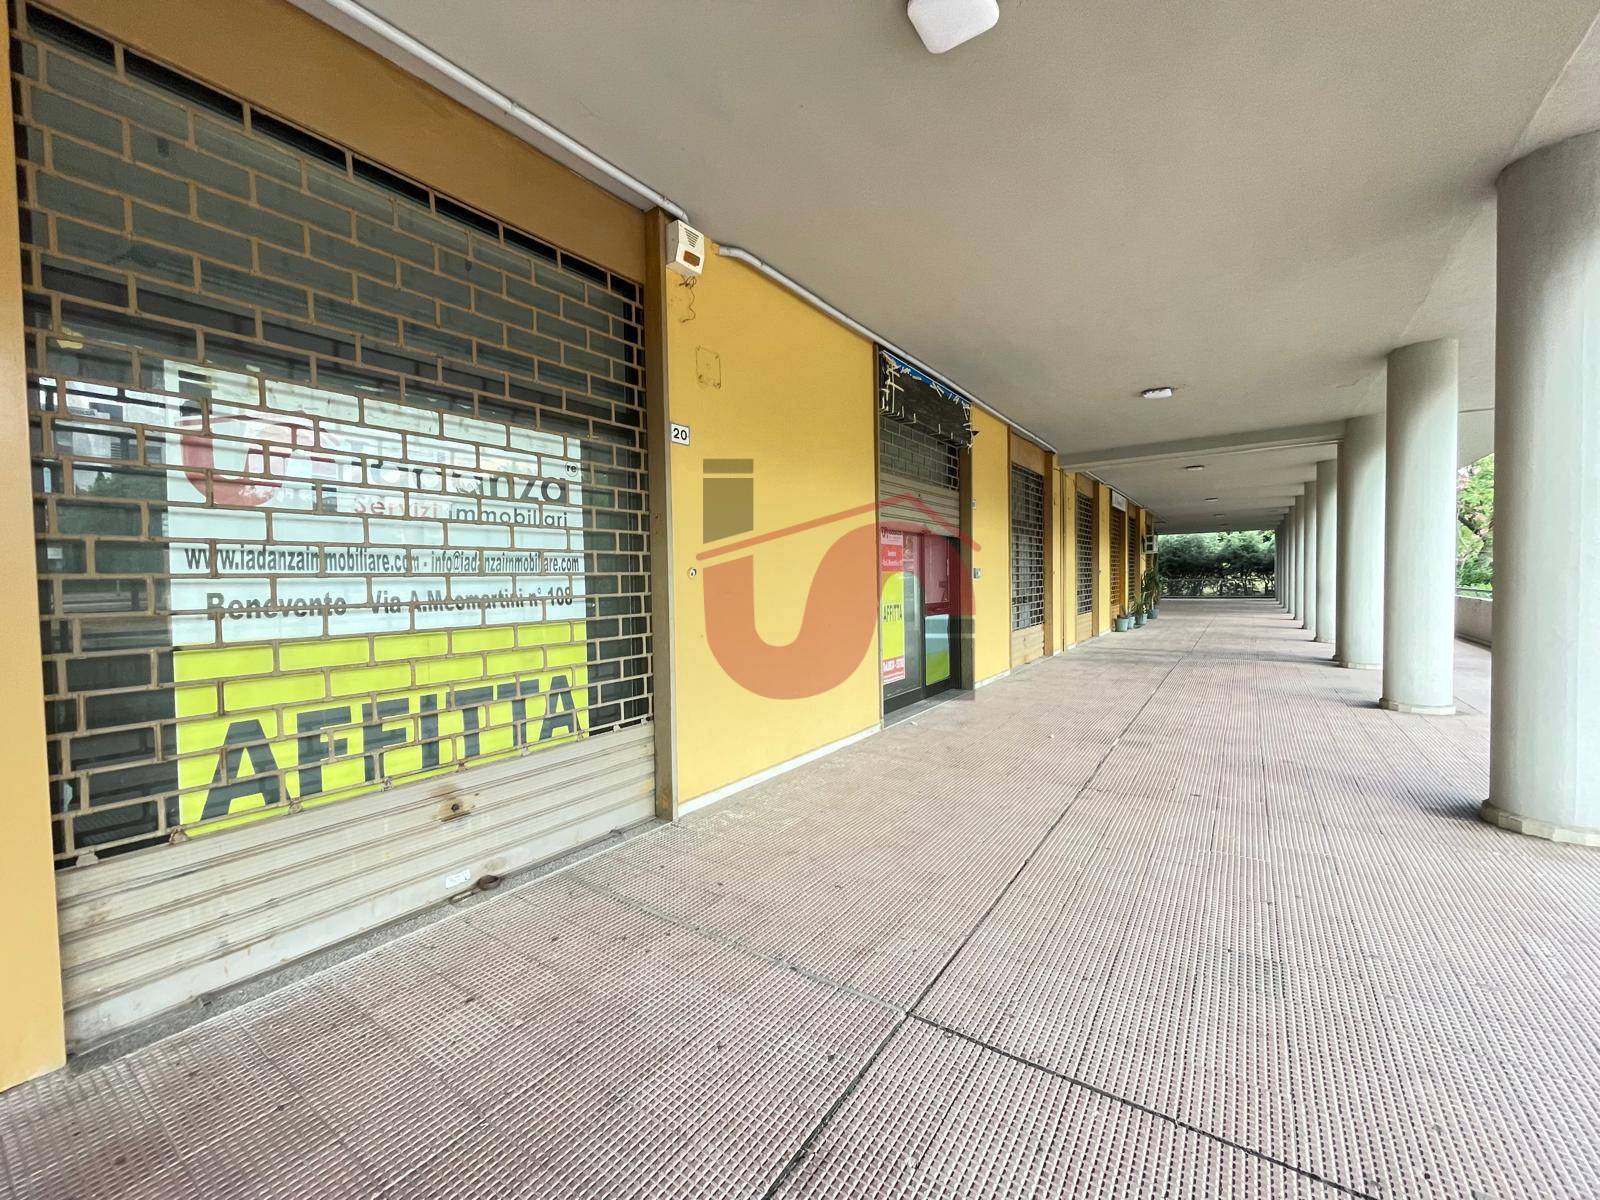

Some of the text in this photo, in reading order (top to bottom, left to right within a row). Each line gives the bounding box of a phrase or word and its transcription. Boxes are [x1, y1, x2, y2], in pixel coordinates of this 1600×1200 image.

[673, 428, 687, 440] 20
[449, 503, 568, 527] immobilari
[431, 550, 580, 572] info@iadnzaimmobiare.com
[207, 591, 346, 620] Benevento
[370, 590, 400, 614] Via
[547, 587, 572, 606] 108
[200, 674, 581, 821] AFFITTA
